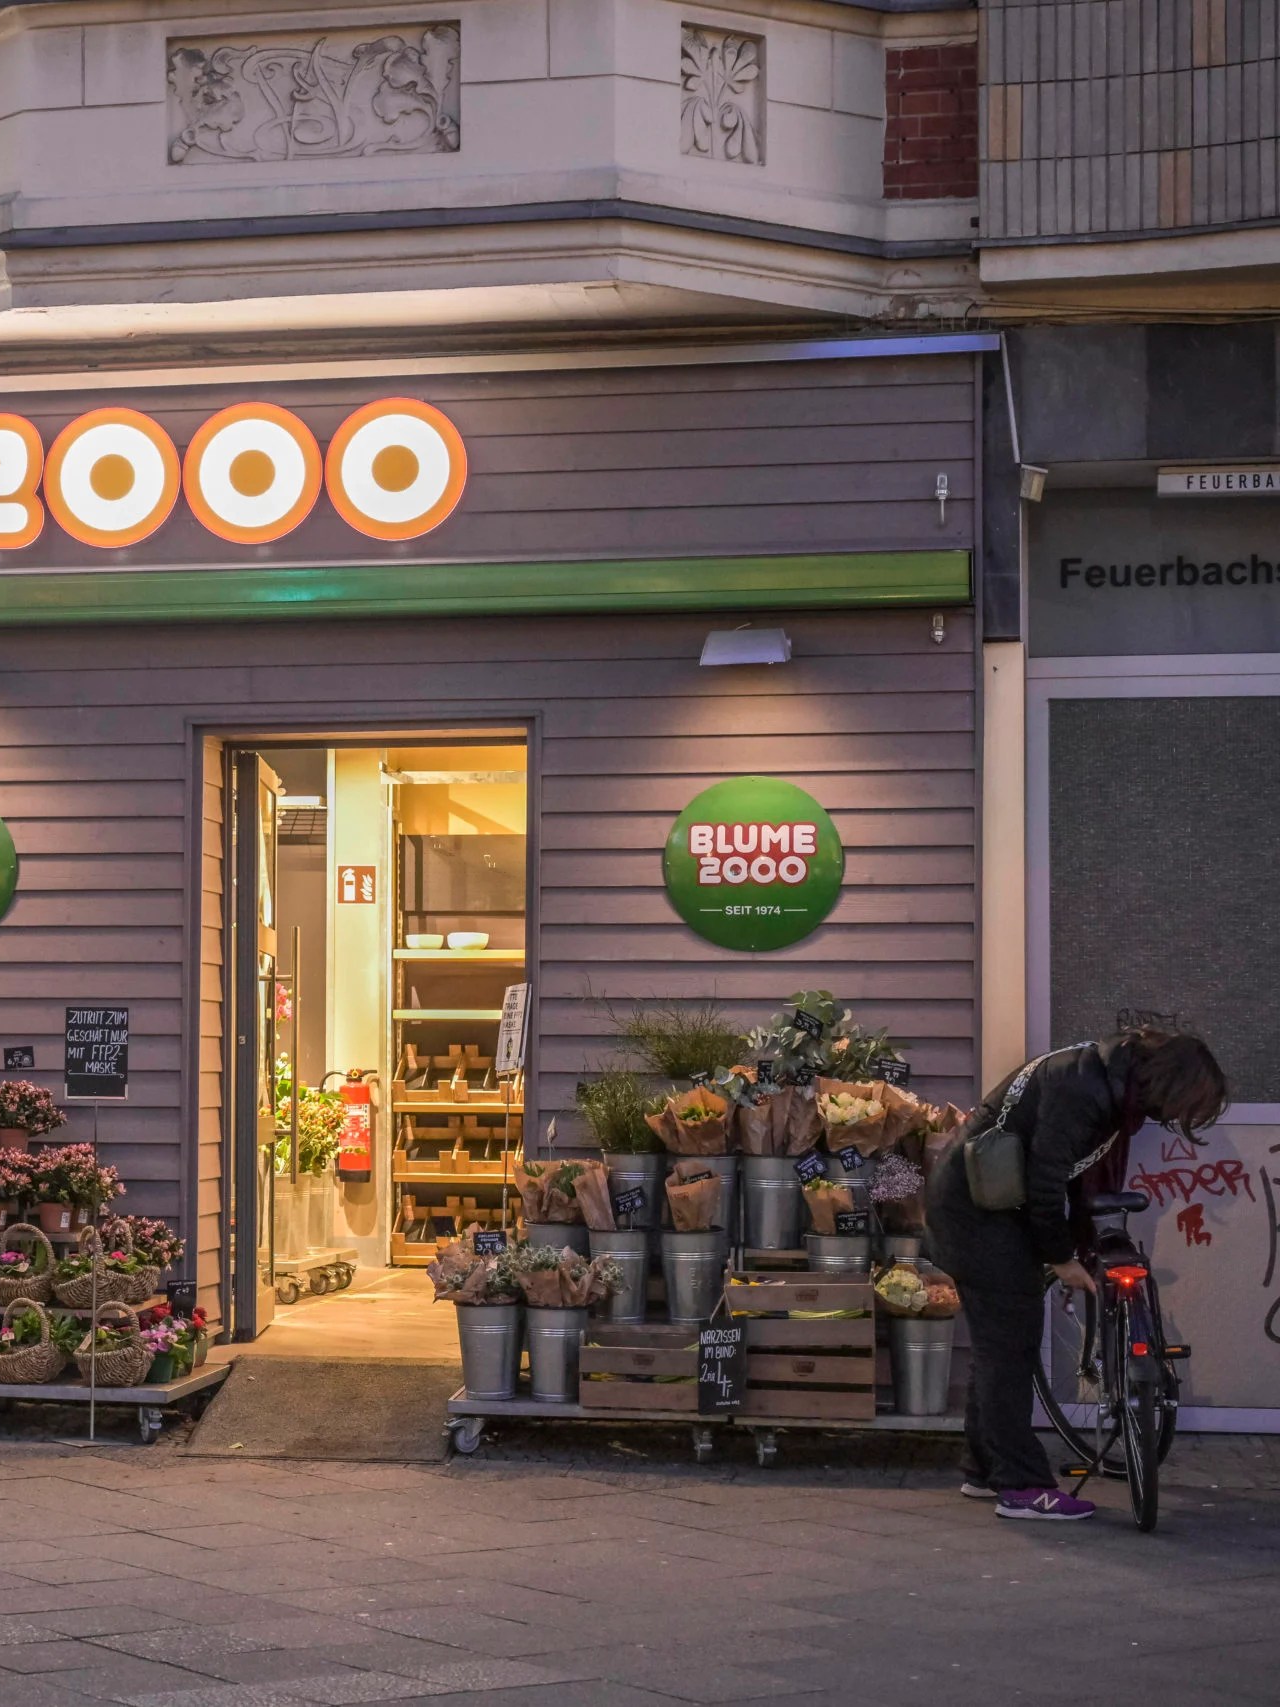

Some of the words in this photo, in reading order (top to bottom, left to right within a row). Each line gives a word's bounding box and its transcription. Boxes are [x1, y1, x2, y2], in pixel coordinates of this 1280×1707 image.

[1185, 473, 1280, 490] FEUERBA
[1059, 553, 1280, 589] Feuerbach
[690, 824, 816, 854] BLUME
[699, 855, 807, 884] 2000
[725, 906, 752, 915] SEIT
[755, 905, 781, 915] 1974
[68, 1010, 105, 1025] ZUTRITT
[106, 1011, 128, 1025] ZUM
[67, 1027, 109, 1042] GESCHÄFT
[110, 1030, 128, 1043] NUR
[67, 1047, 86, 1059] MIT
[85, 1061, 117, 1074] MASKE
[700, 1328, 741, 1345] NARZISSEN
[704, 1346, 714, 1359] IM
